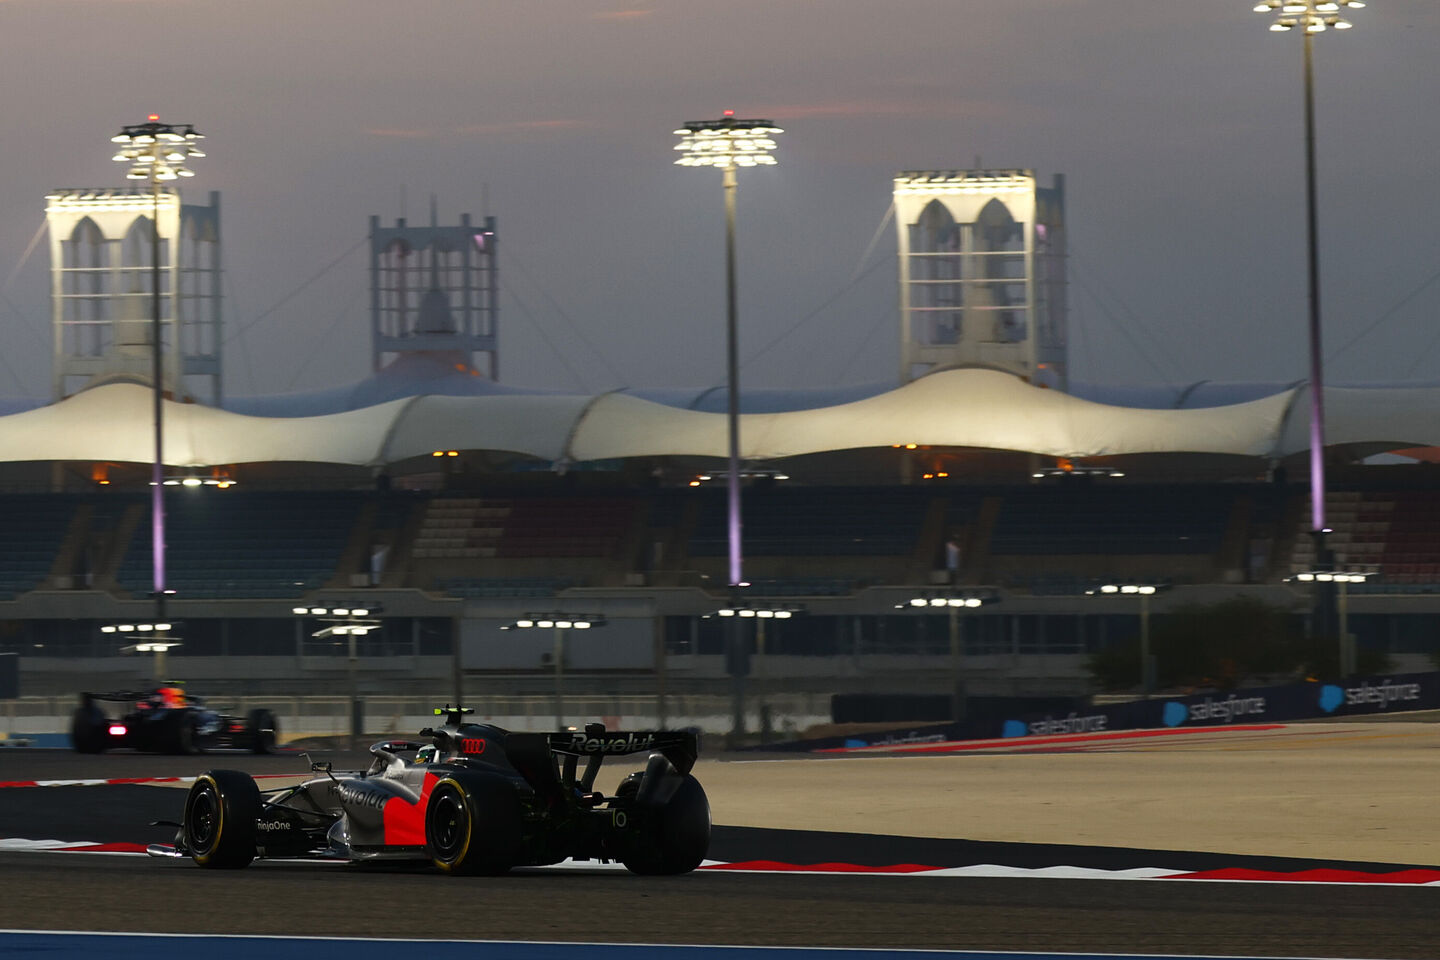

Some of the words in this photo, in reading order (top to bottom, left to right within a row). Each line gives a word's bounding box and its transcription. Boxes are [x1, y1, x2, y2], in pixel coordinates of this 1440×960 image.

[1345, 680, 1421, 708] salesforce
[1188, 694, 1266, 722] salesforce
[1028, 711, 1108, 736] salesforce
[568, 732, 656, 753] Revolut
